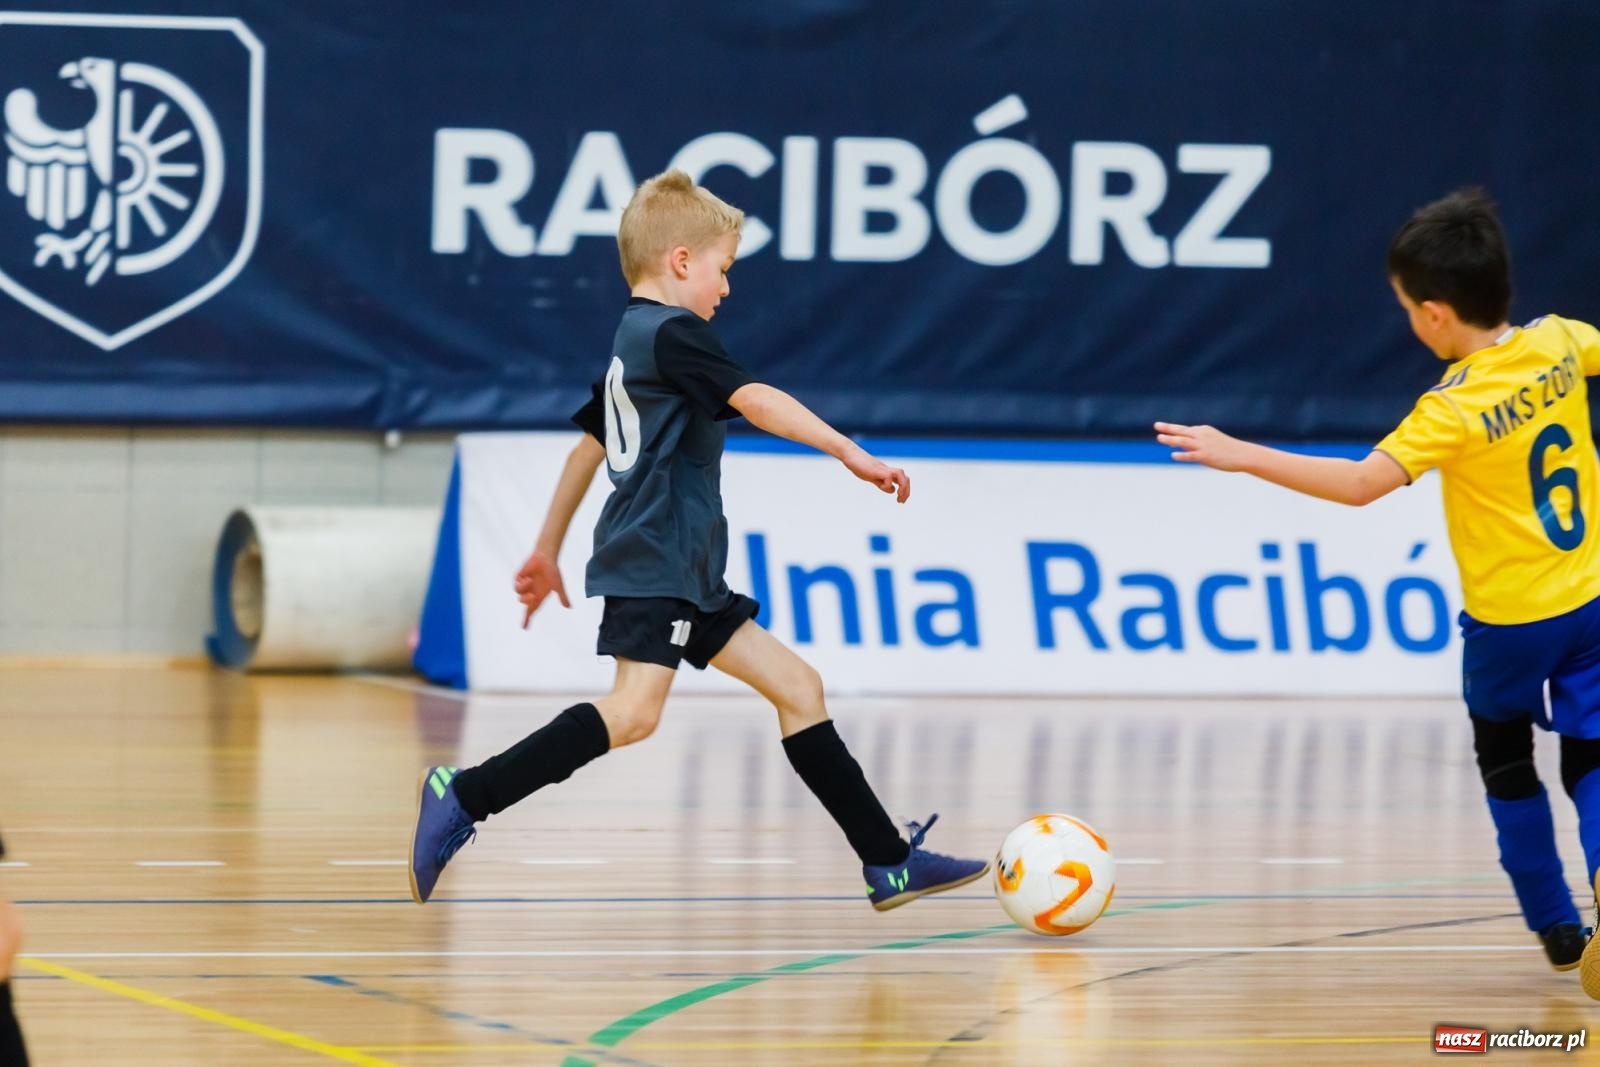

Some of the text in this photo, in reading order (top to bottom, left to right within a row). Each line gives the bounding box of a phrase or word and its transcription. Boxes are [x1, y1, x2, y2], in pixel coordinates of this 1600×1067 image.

[432, 95, 1272, 268] RACIBÓRZ
[1480, 386, 1536, 443] MKS
[1528, 423, 1586, 551] 6
